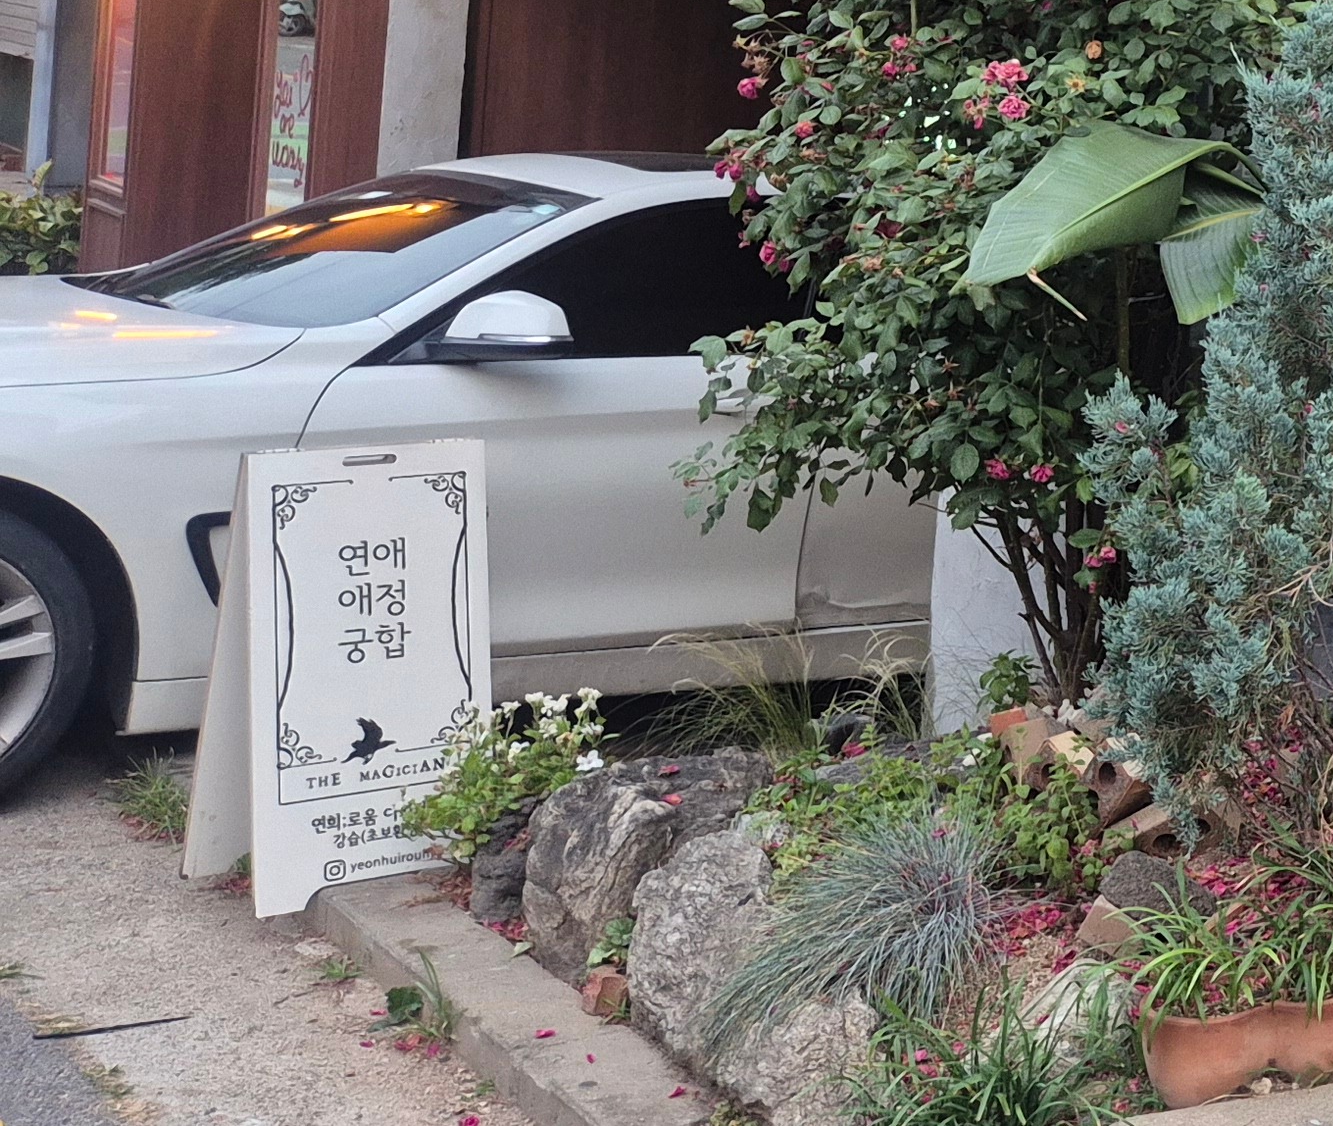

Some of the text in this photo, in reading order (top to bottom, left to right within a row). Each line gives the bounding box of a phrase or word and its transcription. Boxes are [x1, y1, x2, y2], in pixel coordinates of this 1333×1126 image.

[338, 536, 406, 576] 연애
[337, 578, 406, 617] 애정
[337, 621, 412, 664] 궁합
[305, 756, 447, 790] THE MAGICIAN
